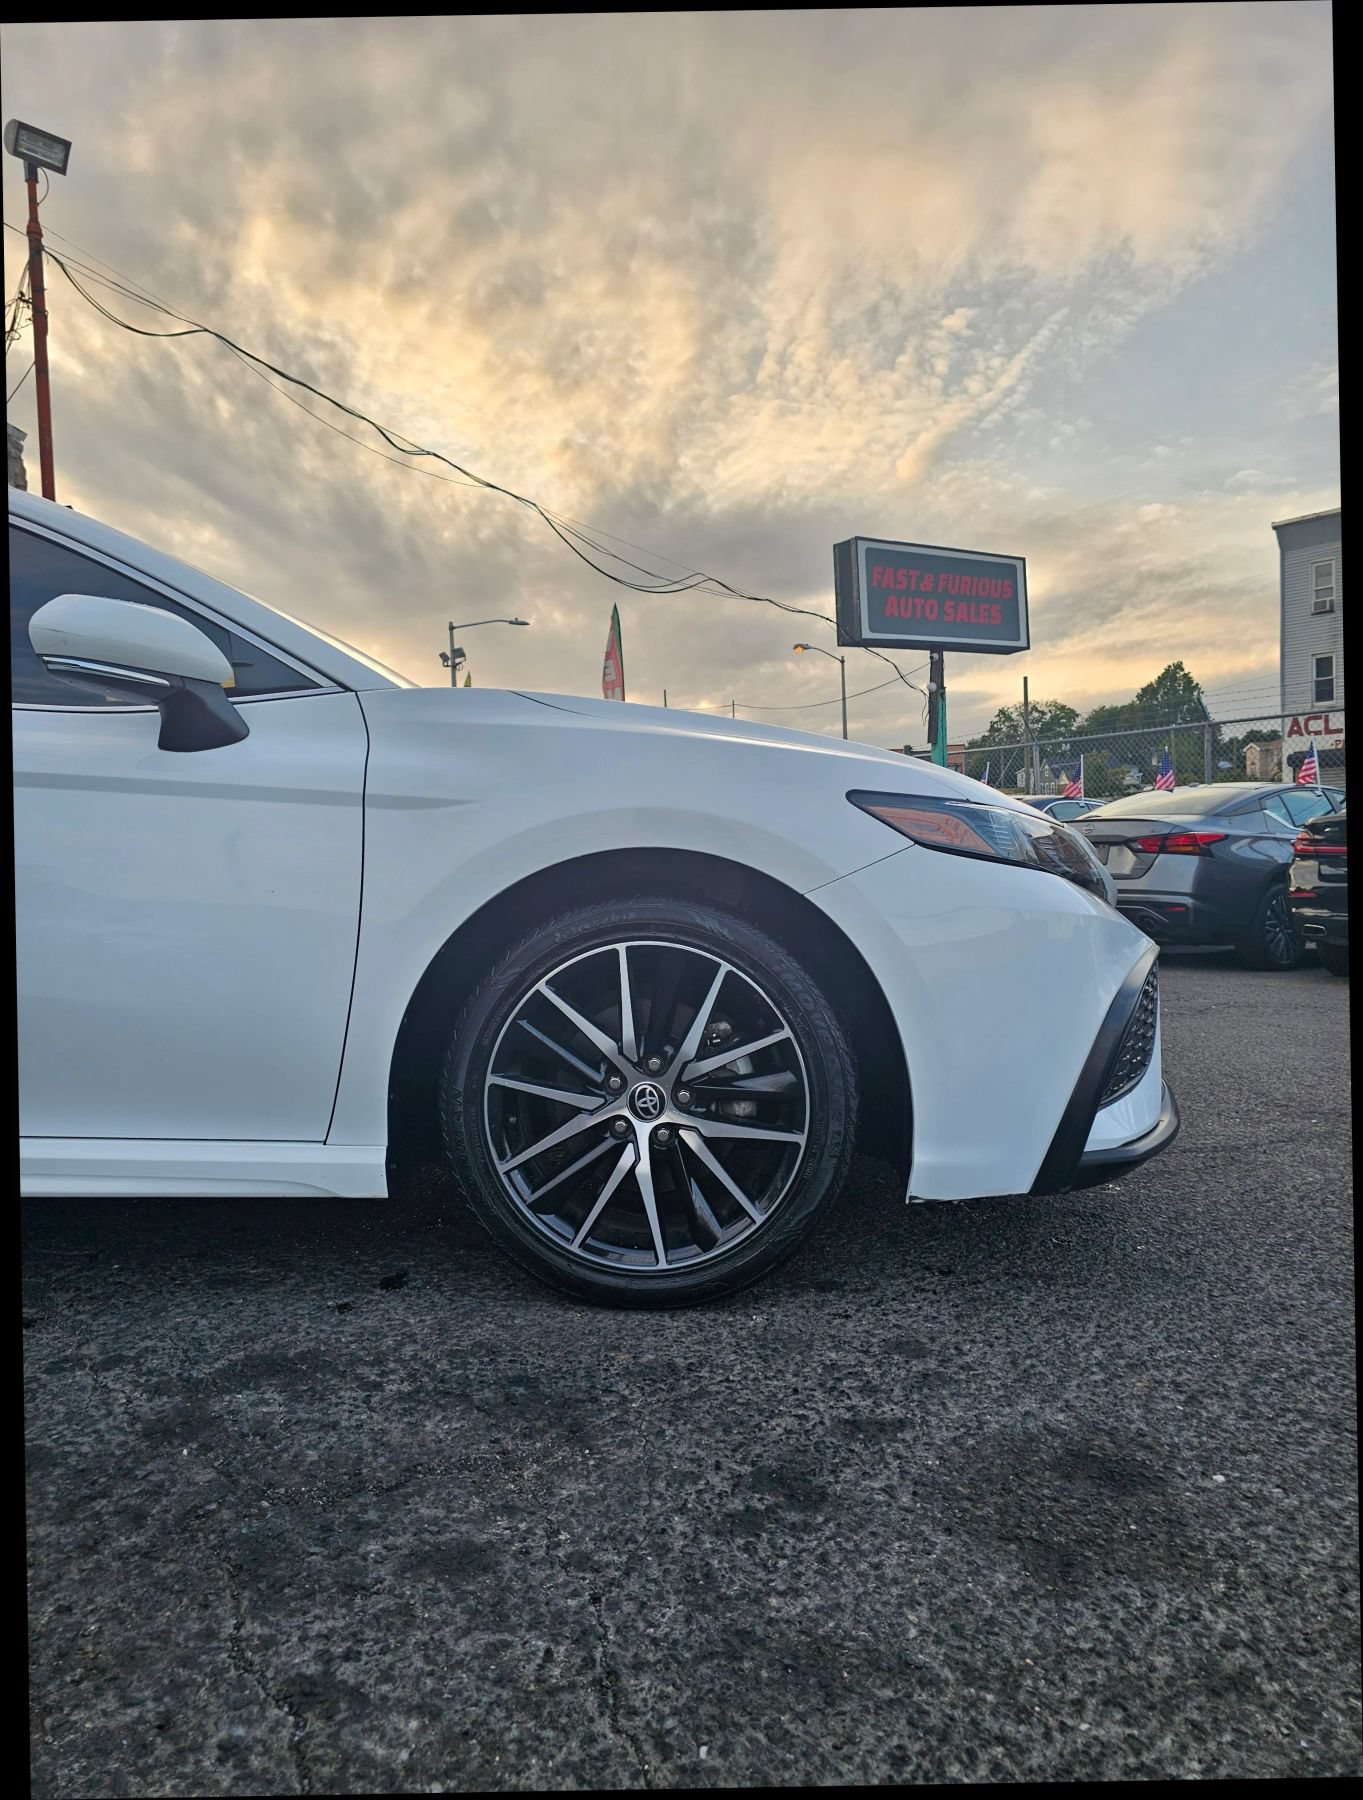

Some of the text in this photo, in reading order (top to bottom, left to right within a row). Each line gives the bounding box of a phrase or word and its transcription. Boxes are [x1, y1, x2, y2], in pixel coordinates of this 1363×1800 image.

[871, 565, 1013, 600] FAST & FURIOUS
[884, 595, 1003, 625] AUTO SALES
[1287, 714, 1344, 738] ACL
